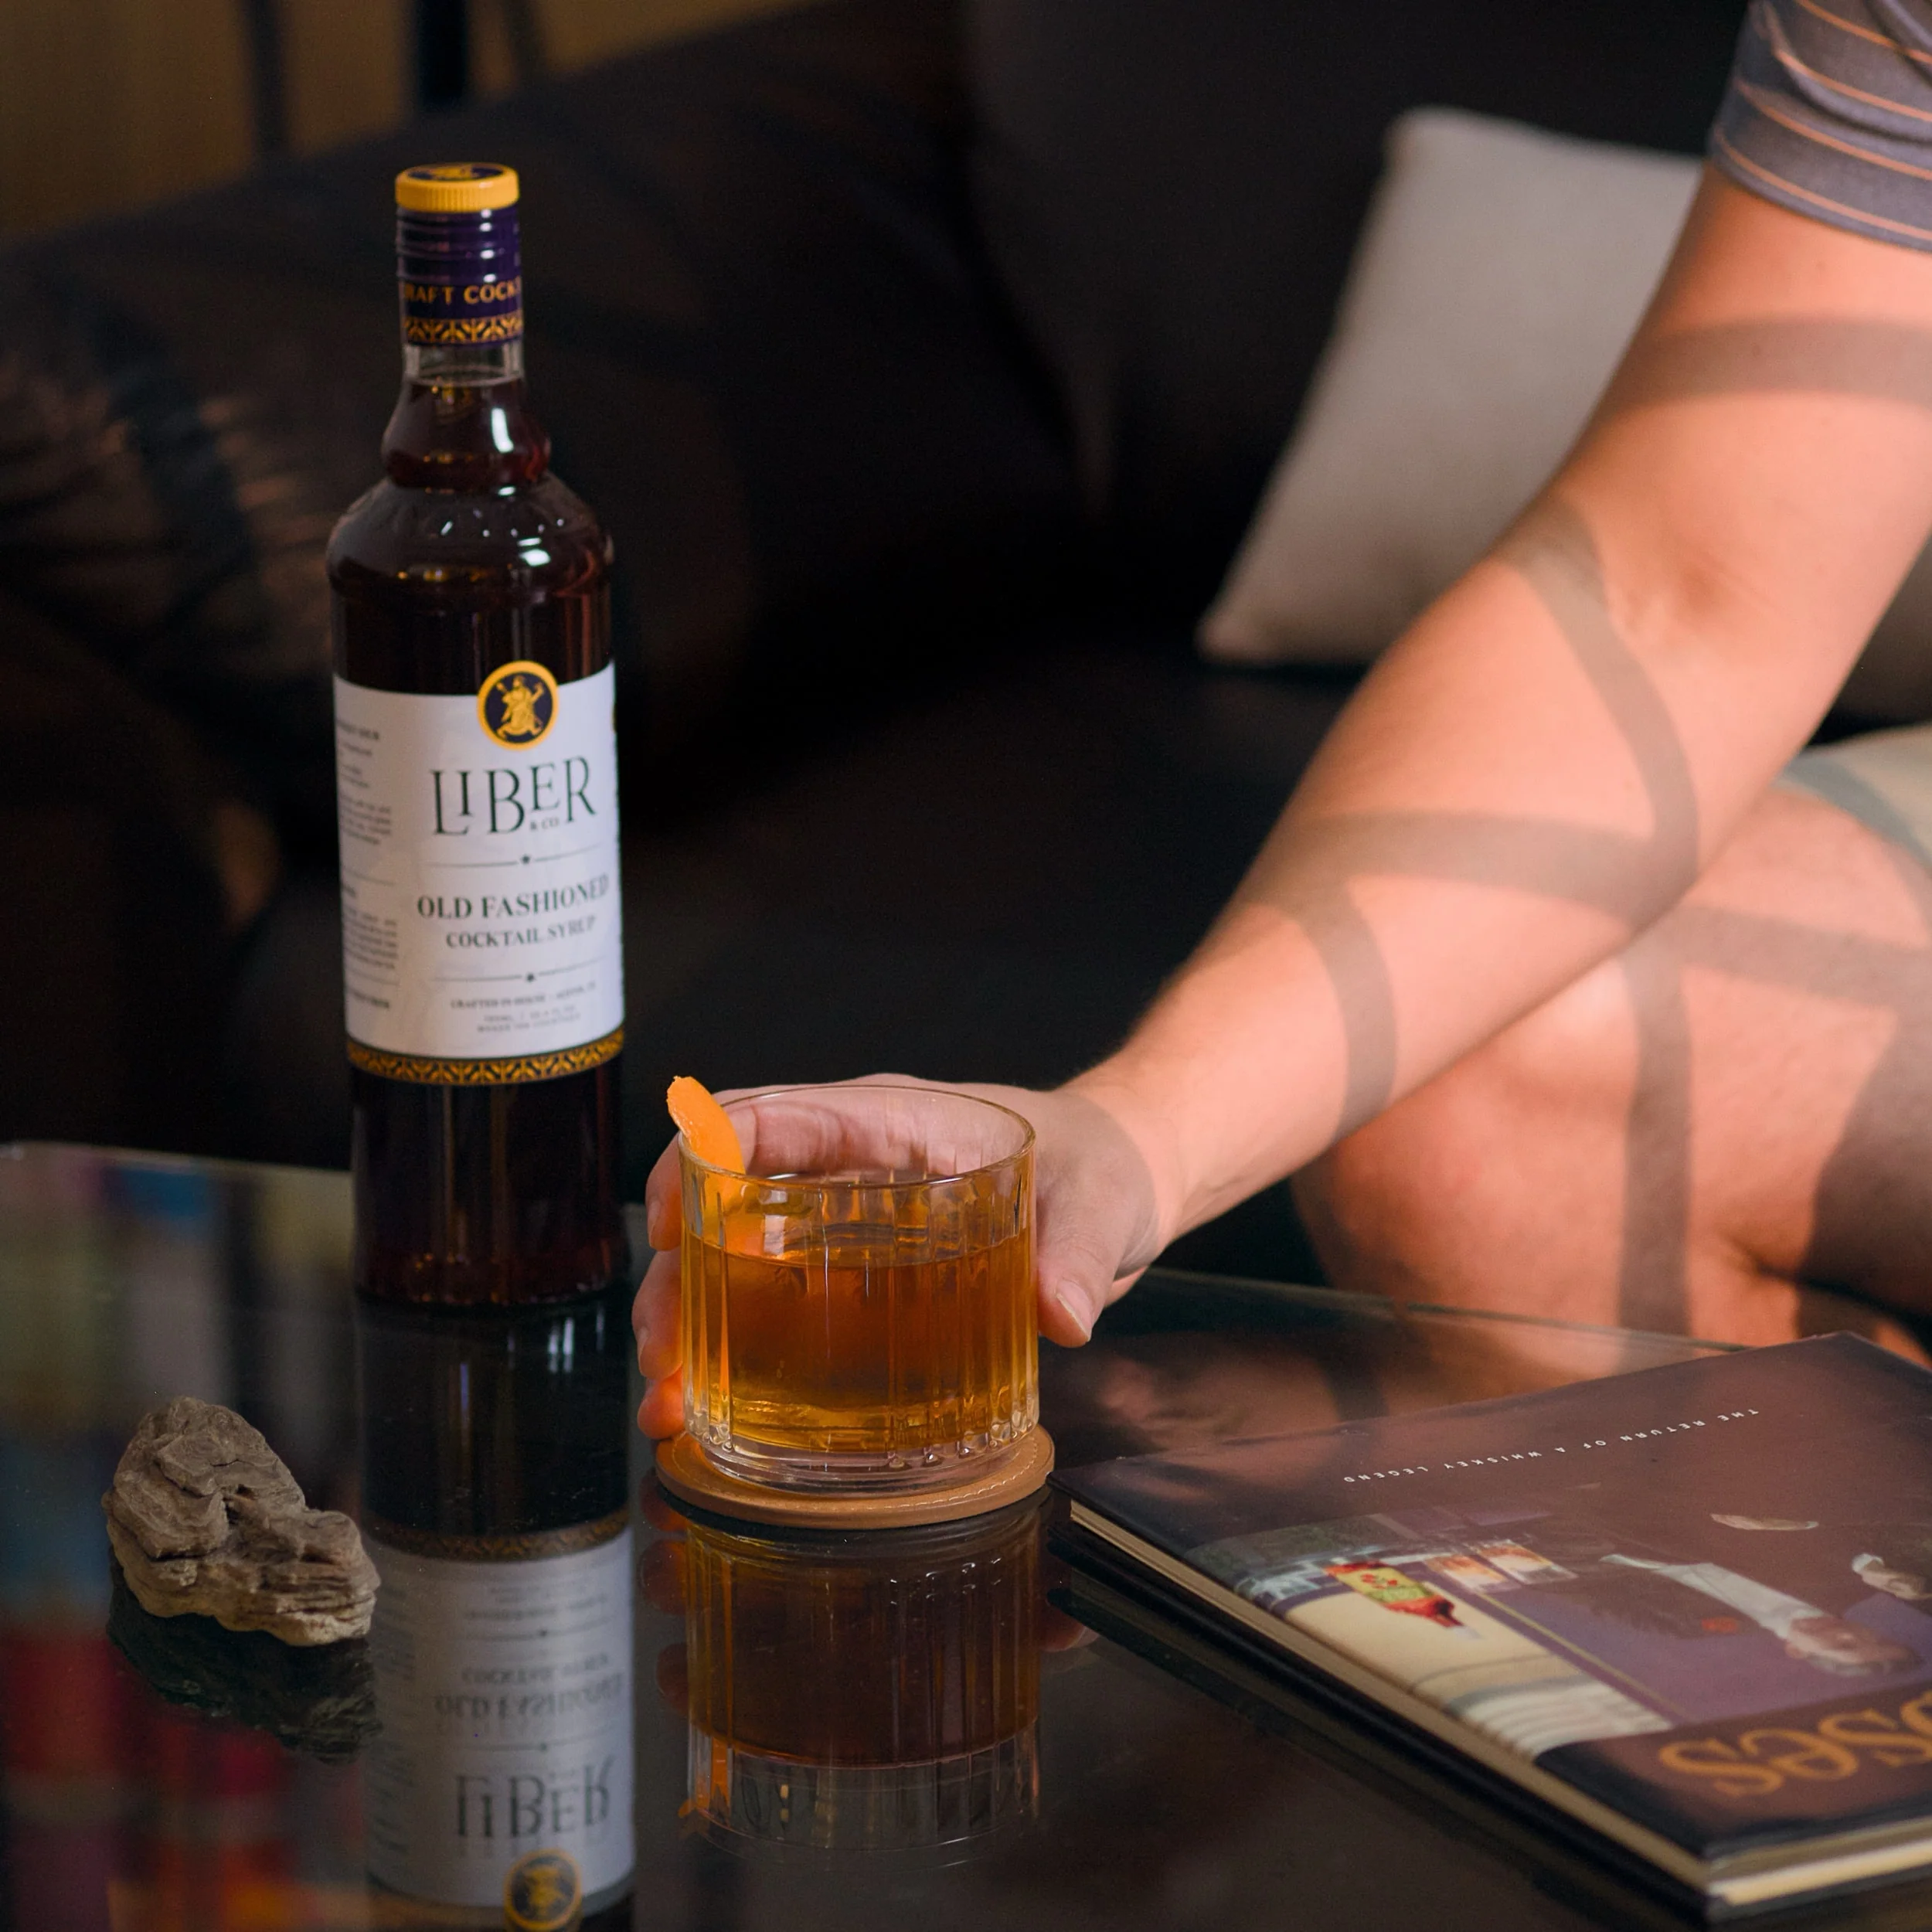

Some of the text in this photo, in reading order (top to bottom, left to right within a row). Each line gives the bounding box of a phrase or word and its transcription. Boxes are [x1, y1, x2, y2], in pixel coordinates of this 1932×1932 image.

[404, 279, 517, 304] RAFT COCK
[430, 755, 597, 836] LIBER
[417, 895, 472, 919] OLD
[481, 872, 610, 919] FASHIONED
[446, 914, 597, 949] COCKTAIL SYRUP
[1717, 1408, 1760, 1421] THE
[1619, 1420, 1706, 1441] RETURN
[1583, 1440, 1607, 1449] OF
[1444, 1451, 1543, 1469] WHISKEY
[1344, 1466, 1429, 1483] LEGEND
